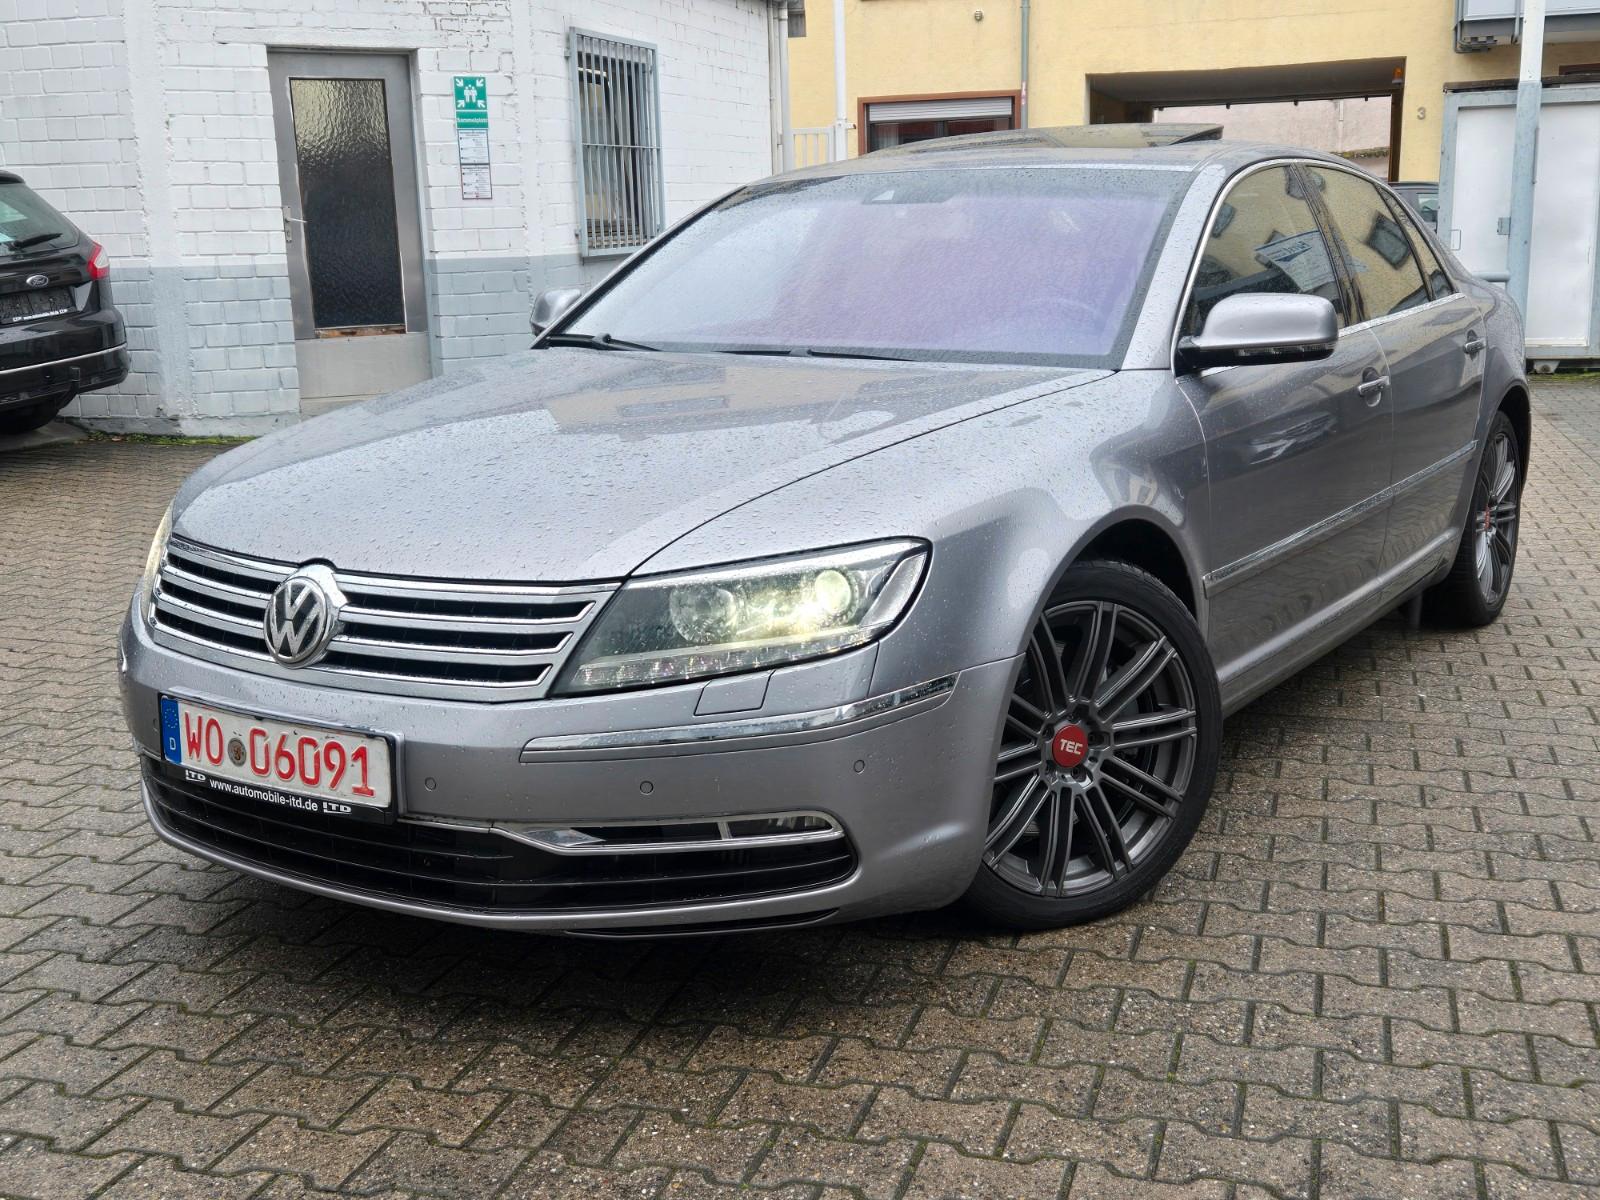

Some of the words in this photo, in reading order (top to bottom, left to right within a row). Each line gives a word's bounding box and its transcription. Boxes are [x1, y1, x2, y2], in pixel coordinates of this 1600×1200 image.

[1417, 106, 1426, 120] 3
[169, 737, 176, 751] D
[185, 711, 223, 765] WO
[250, 728, 375, 797] 06091
[1060, 739, 1083, 755] TEC
[209, 778, 318, 812] www.automobile-itd.de
